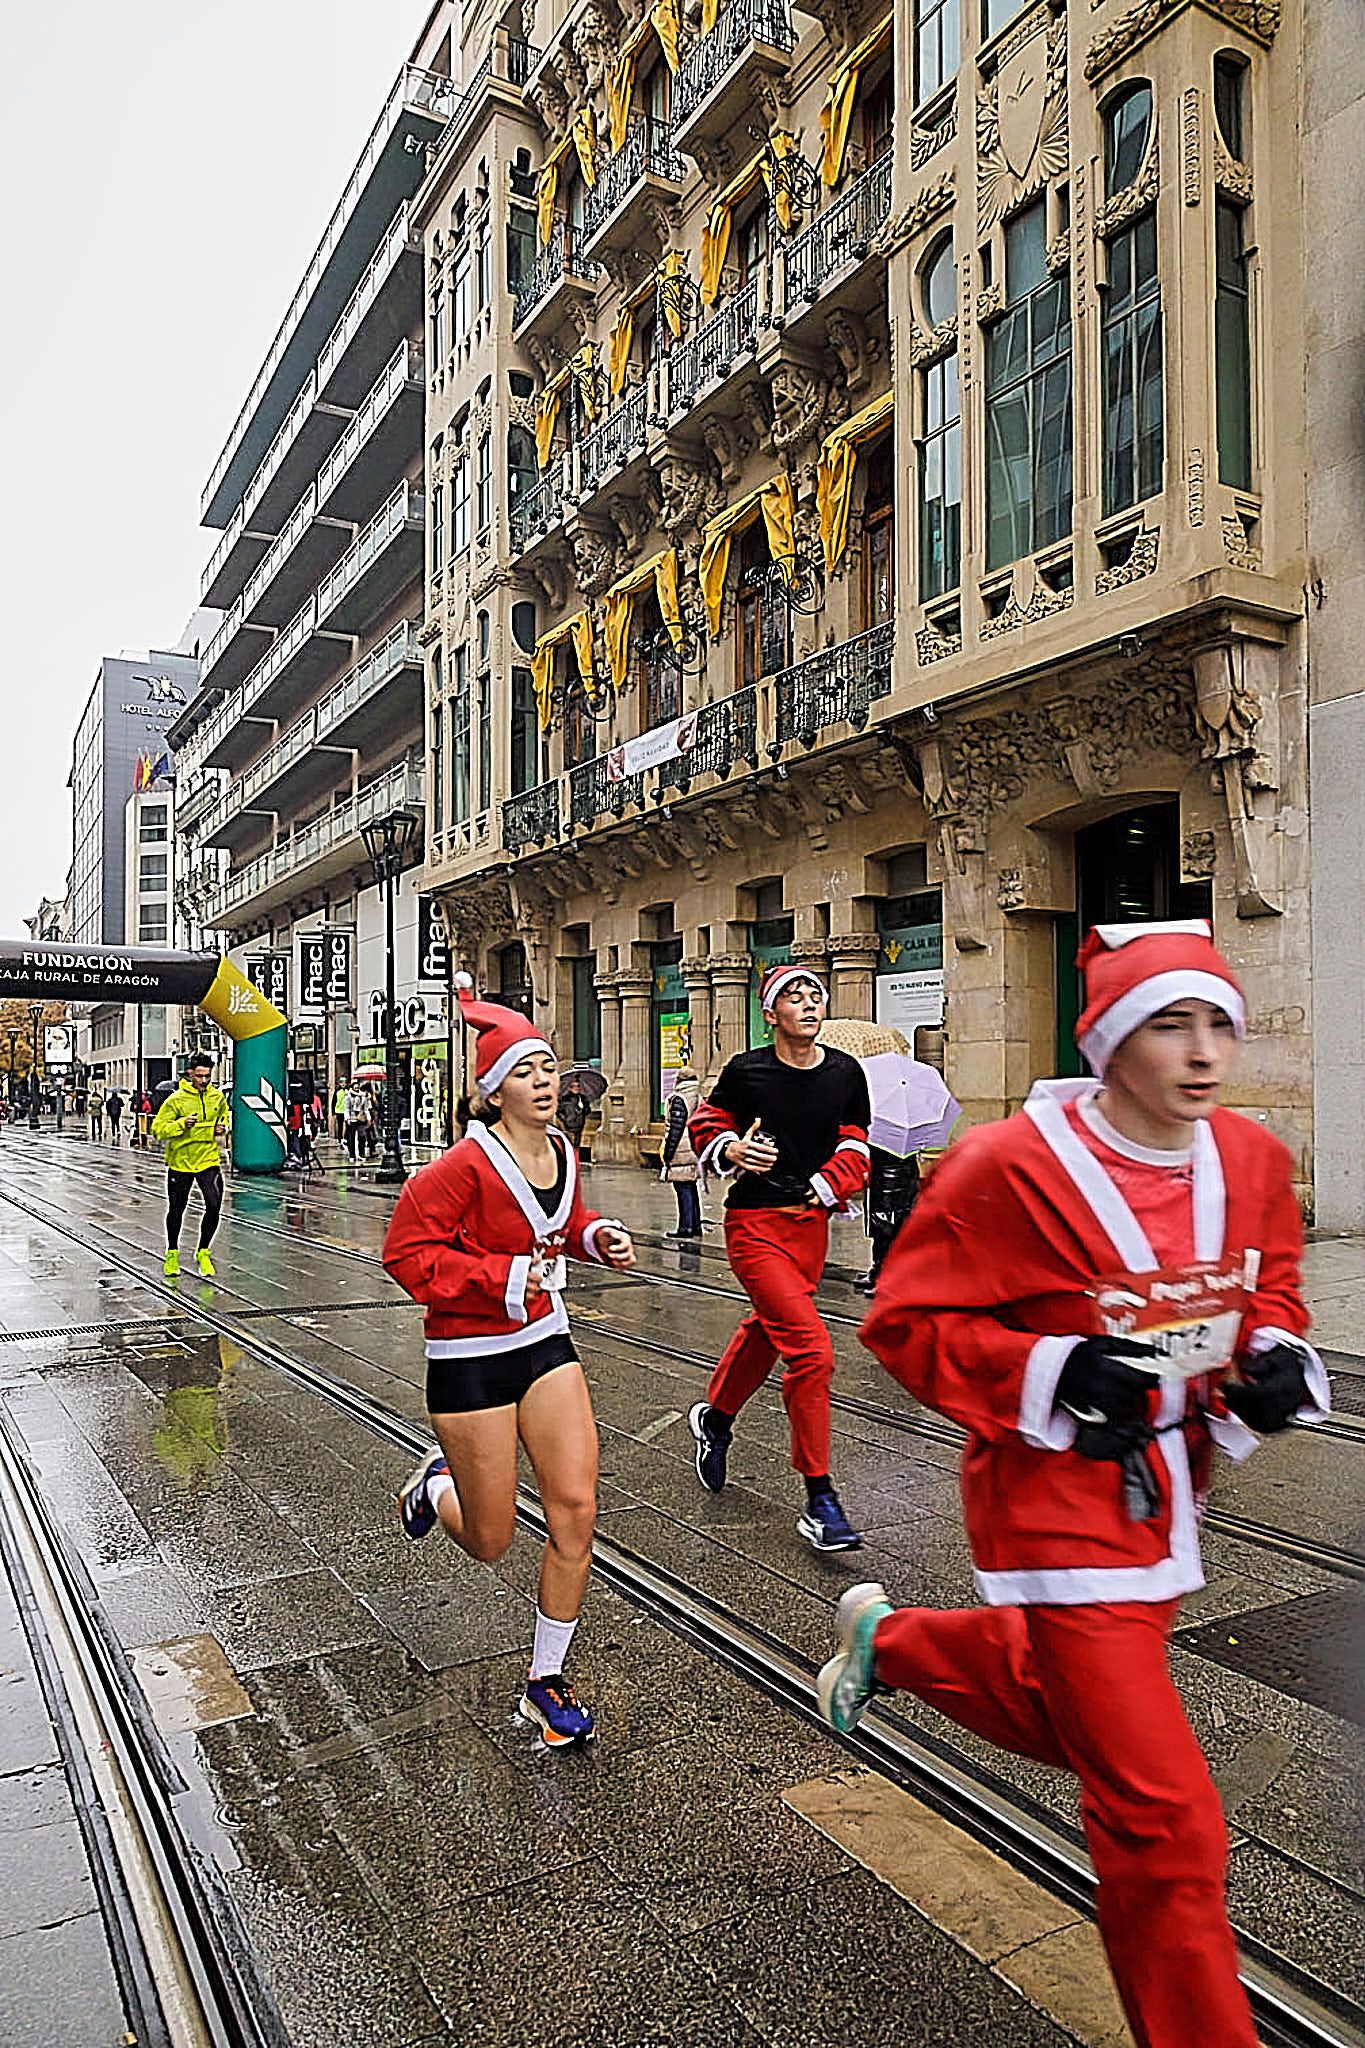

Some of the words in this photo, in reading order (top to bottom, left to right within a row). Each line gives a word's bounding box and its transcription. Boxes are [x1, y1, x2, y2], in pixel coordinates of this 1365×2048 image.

[121, 703, 152, 716] HOTEL
[423, 901, 446, 976] fnac
[22, 951, 133, 971] FUNDACIÓN
[34, 970, 79, 983] RURAL
[83, 973, 100, 984] DE
[104, 974, 159, 986] ARAGÓN
[304, 945, 323, 1003] fnac
[326, 937, 346, 998] fnac
